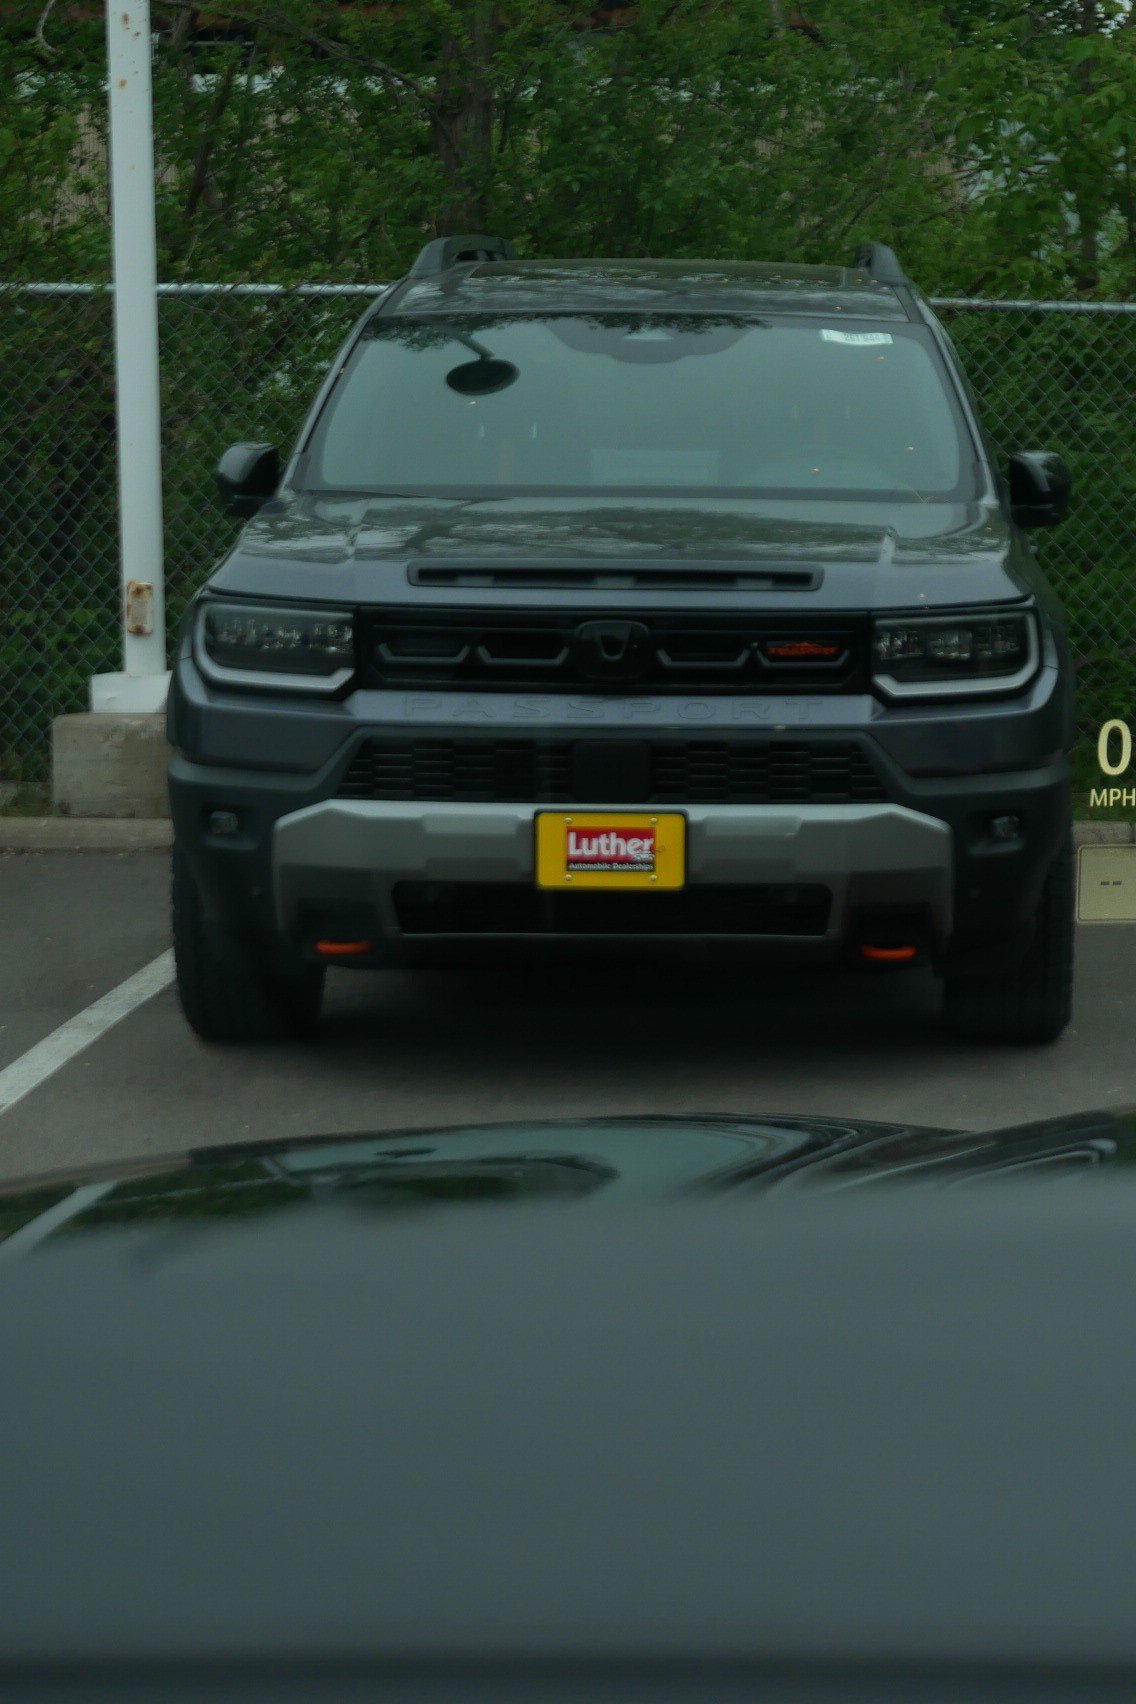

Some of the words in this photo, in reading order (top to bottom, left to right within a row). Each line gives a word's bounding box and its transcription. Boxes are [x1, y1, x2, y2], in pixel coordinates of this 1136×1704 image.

[403, 695, 823, 719] PASSPORT
[1098, 719, 1132, 776] 0
[1090, 788, 1136, 807] MPH
[568, 831, 654, 855] Luther
